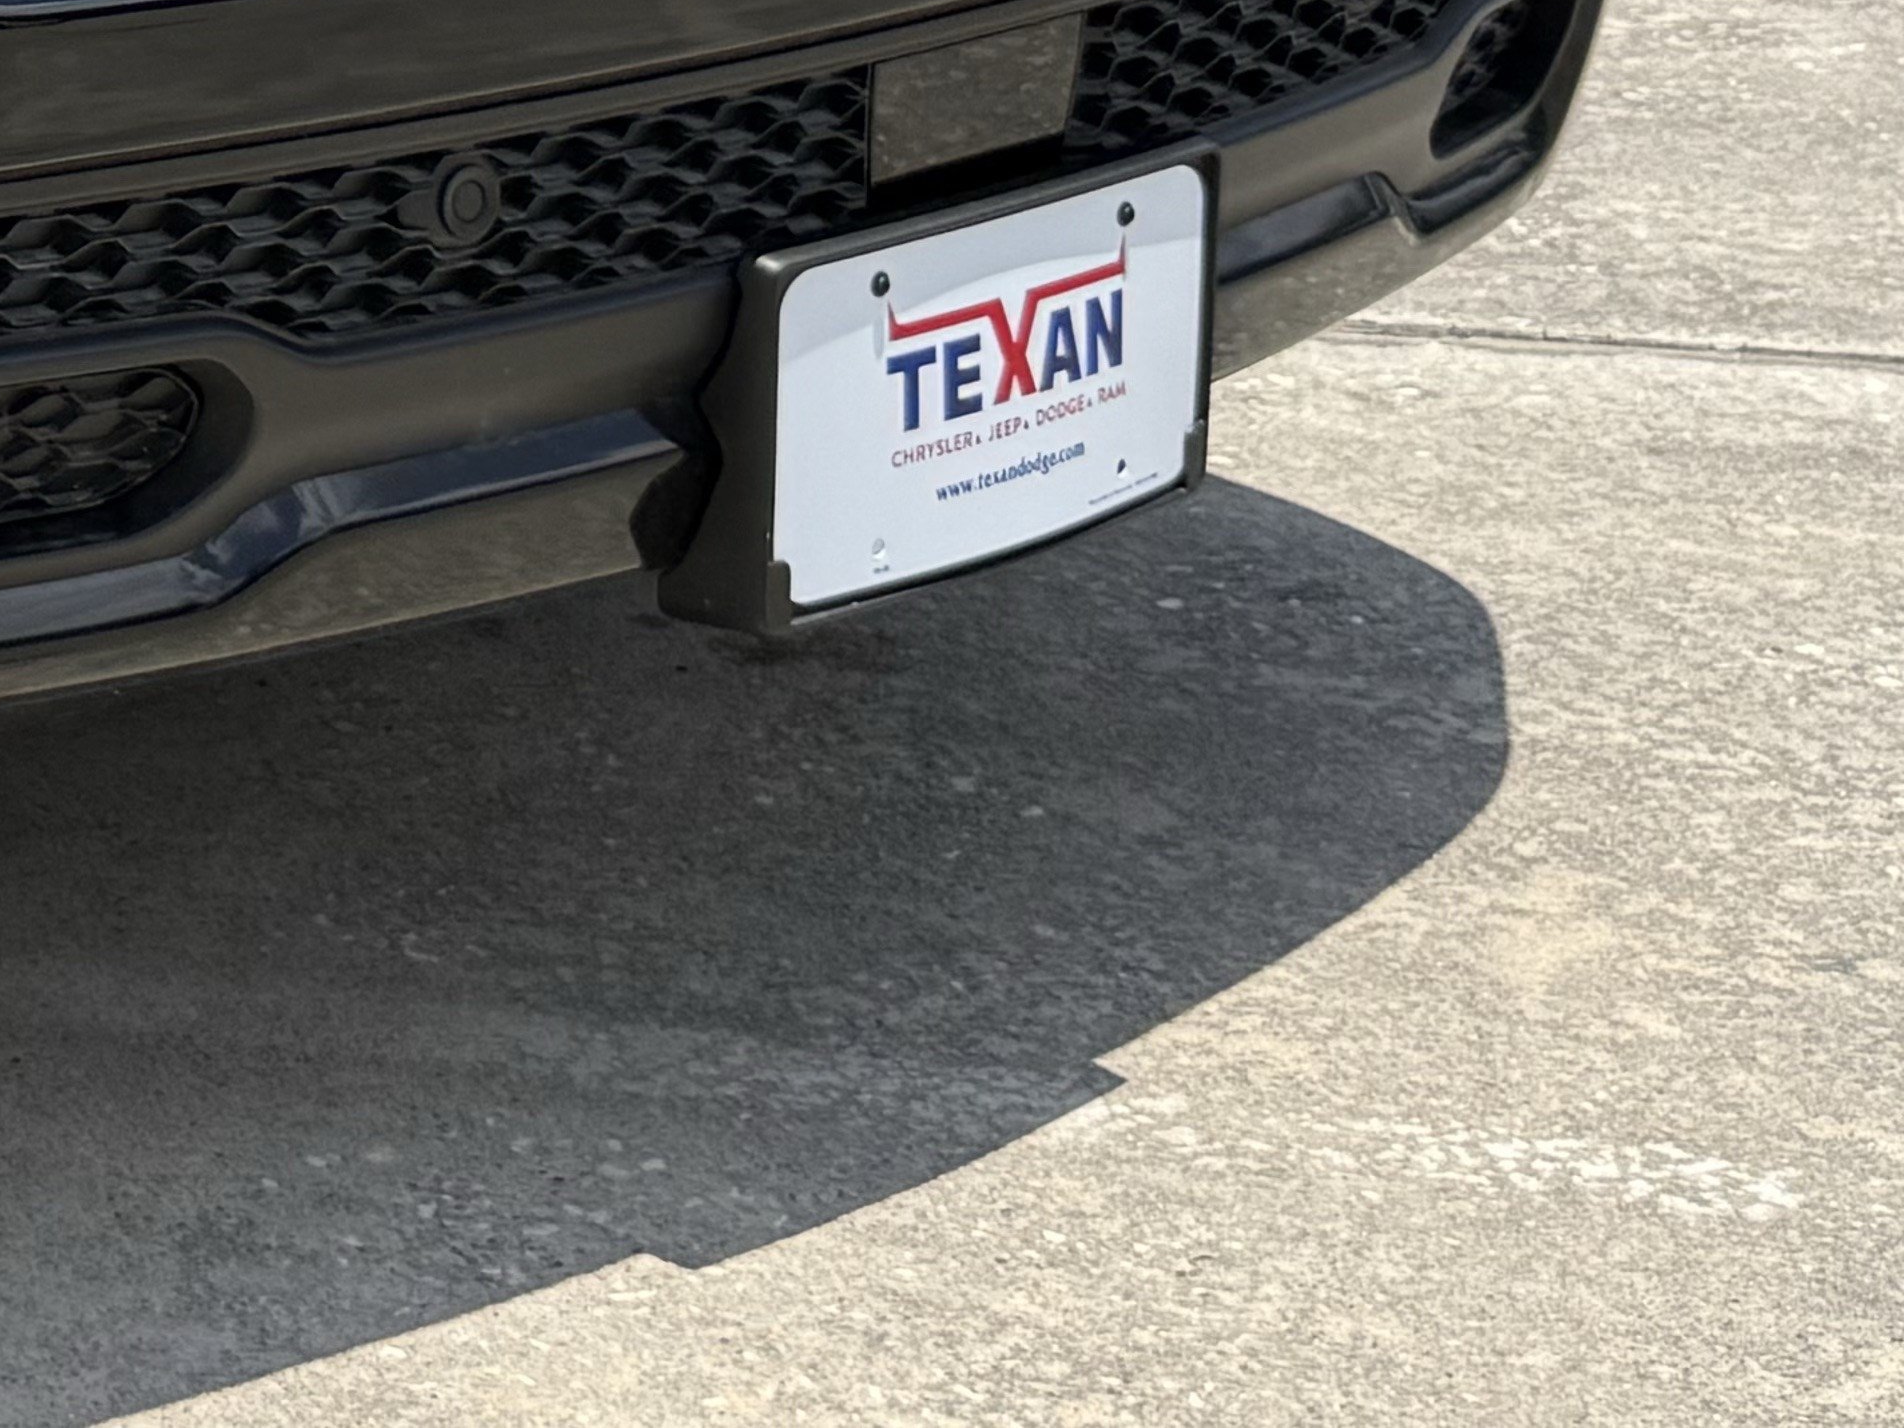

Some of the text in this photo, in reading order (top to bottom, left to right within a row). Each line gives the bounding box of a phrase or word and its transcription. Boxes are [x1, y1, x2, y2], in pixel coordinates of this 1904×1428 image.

[886, 281, 1126, 432] TEXAN
[891, 382, 1126, 469] CHRYSLER JEEP DODGE RAM
[935, 439, 1085, 502] www.texandodge.com
